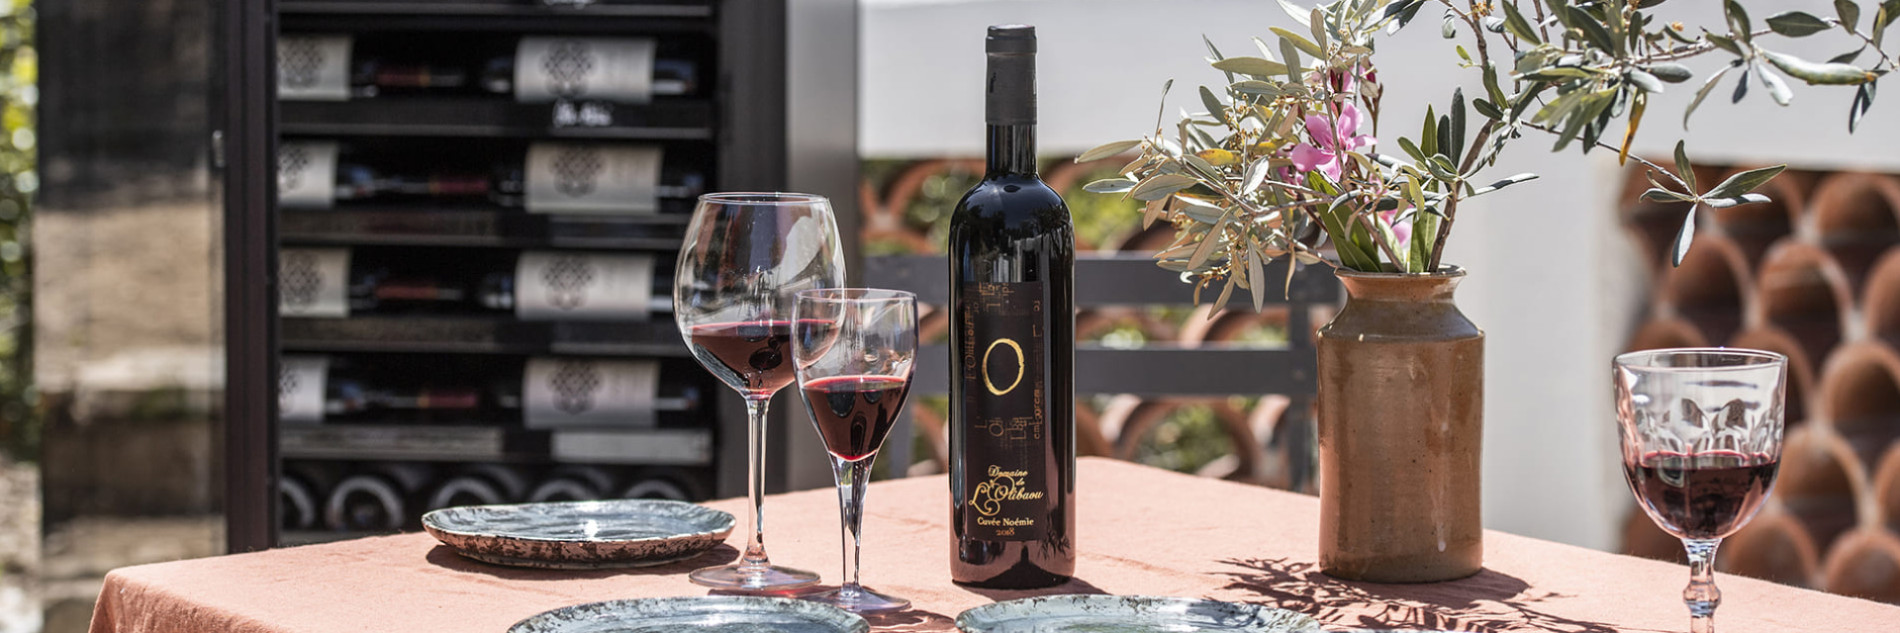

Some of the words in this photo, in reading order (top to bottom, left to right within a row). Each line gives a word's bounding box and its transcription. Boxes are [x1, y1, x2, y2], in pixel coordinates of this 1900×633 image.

[988, 465, 1028, 477] Domaine
[977, 516, 1001, 526] Cuvée
[1003, 516, 1034, 526] Noémie
[996, 528, 1015, 536] 2018
